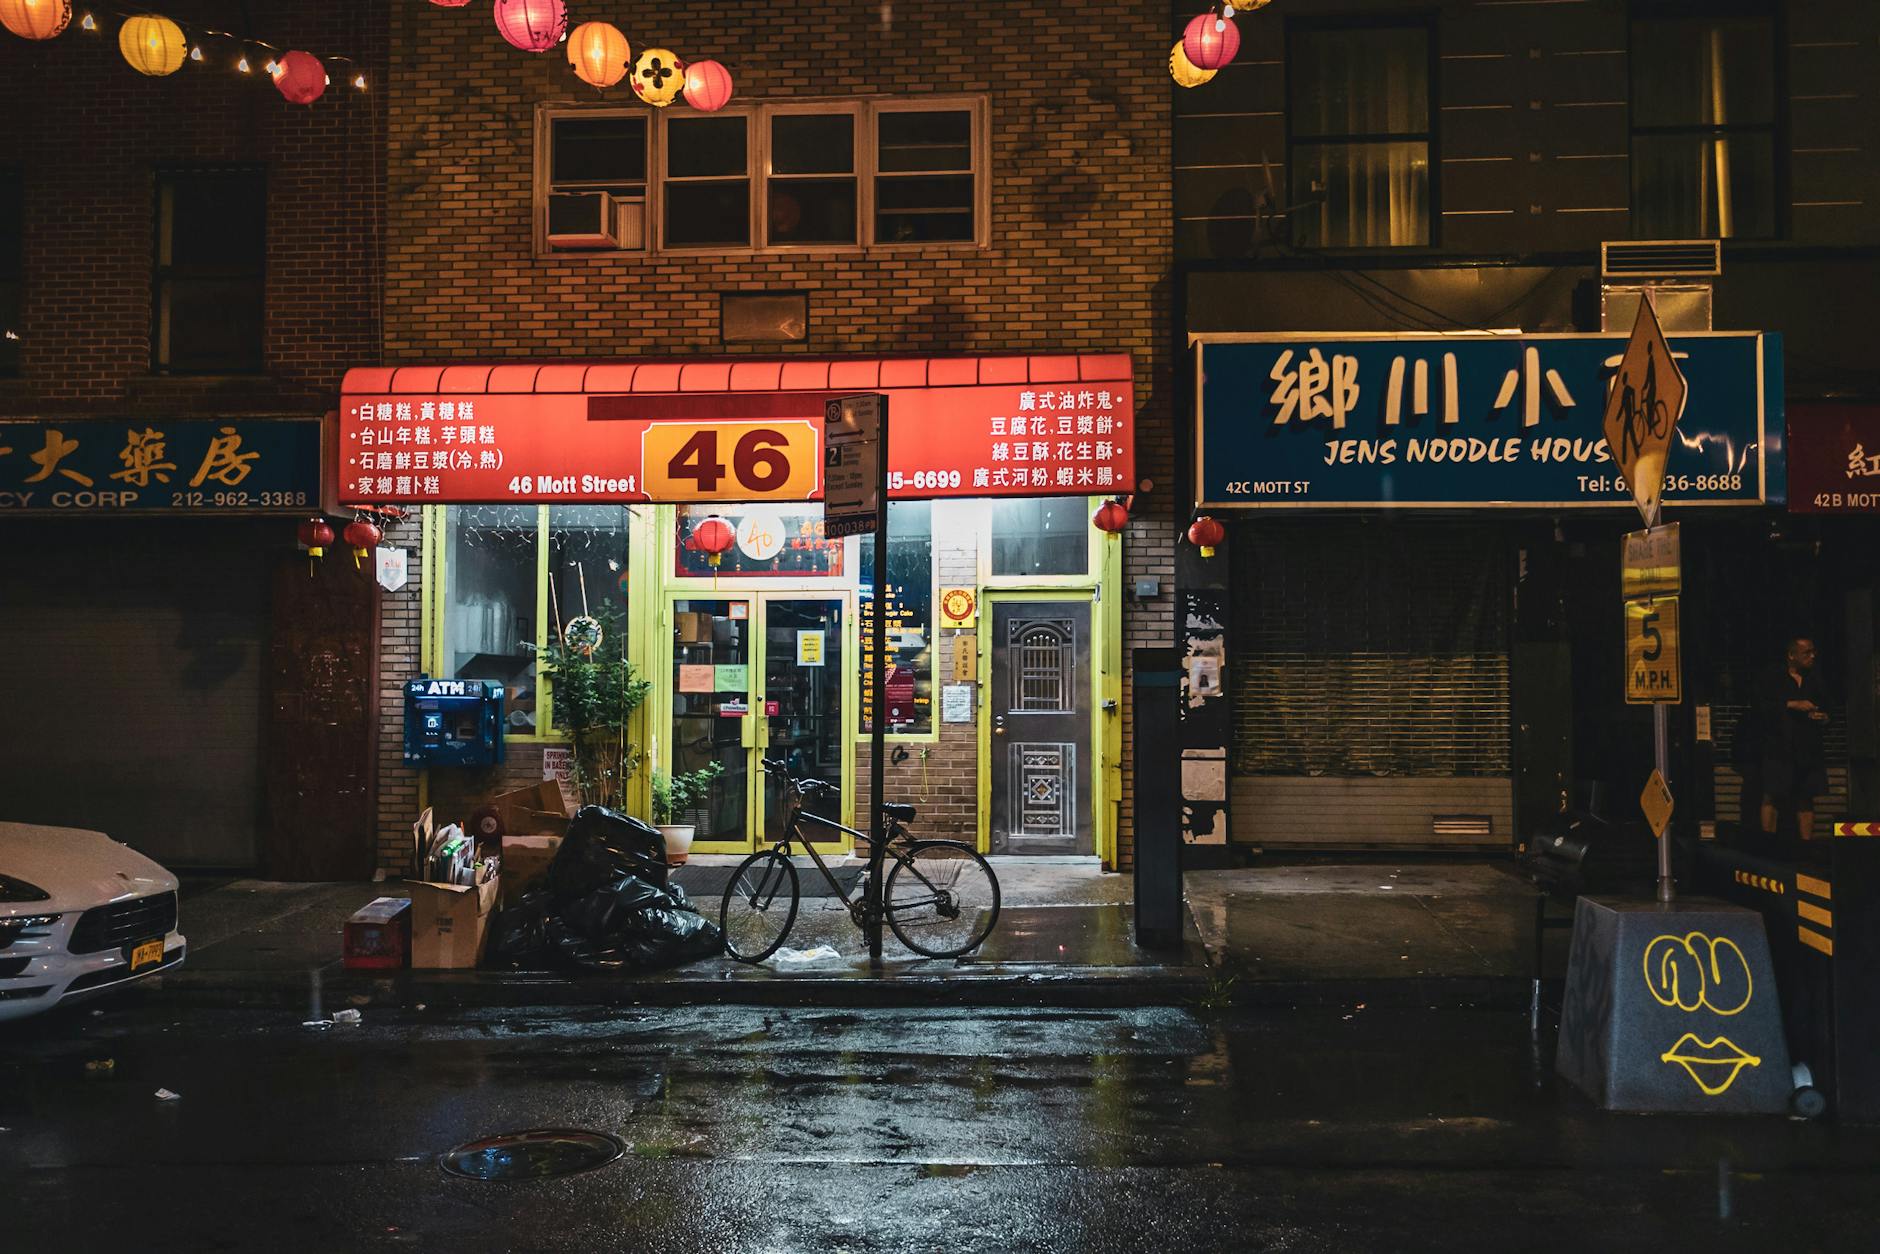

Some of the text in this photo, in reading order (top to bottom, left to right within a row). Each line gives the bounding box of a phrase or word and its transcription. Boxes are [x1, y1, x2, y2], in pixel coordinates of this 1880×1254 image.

[1270, 346, 1689, 429] 鄉川小
[1019, 390, 1113, 410] 廣式油炸鬼
[360, 402, 474, 422] 白糖糕,黃糖糕
[360, 426, 496, 445] 台山年糕,芋頭糕
[990, 415, 1113, 436] 豆腐花,豆漿餅
[0, 426, 260, 488] 大藥房
[359, 448, 504, 470] 石磨鮮豆漿(冷,熱)
[668, 430, 790, 492] 46
[992, 441, 1113, 462] 綠豆酥,花生酥
[1324, 437, 1616, 466] JENS NOODLE HOUS
[508, 475, 636, 494] 46 Mott Street
[886, 470, 961, 490] 15-6699
[972, 466, 1113, 488] 廣式河粉,蝦米腸
[1577, 475, 1610, 492] Tel:
[1226, 481, 1310, 494] 42C MOTT ST
[52, 491, 139, 508] CORP
[172, 491, 306, 507] 212-962-3388
[1814, 493, 1842, 508] 42B
[1642, 613, 1662, 662] 5
[428, 681, 465, 696] ATM
[1635, 670, 1673, 690] M.P.H.
